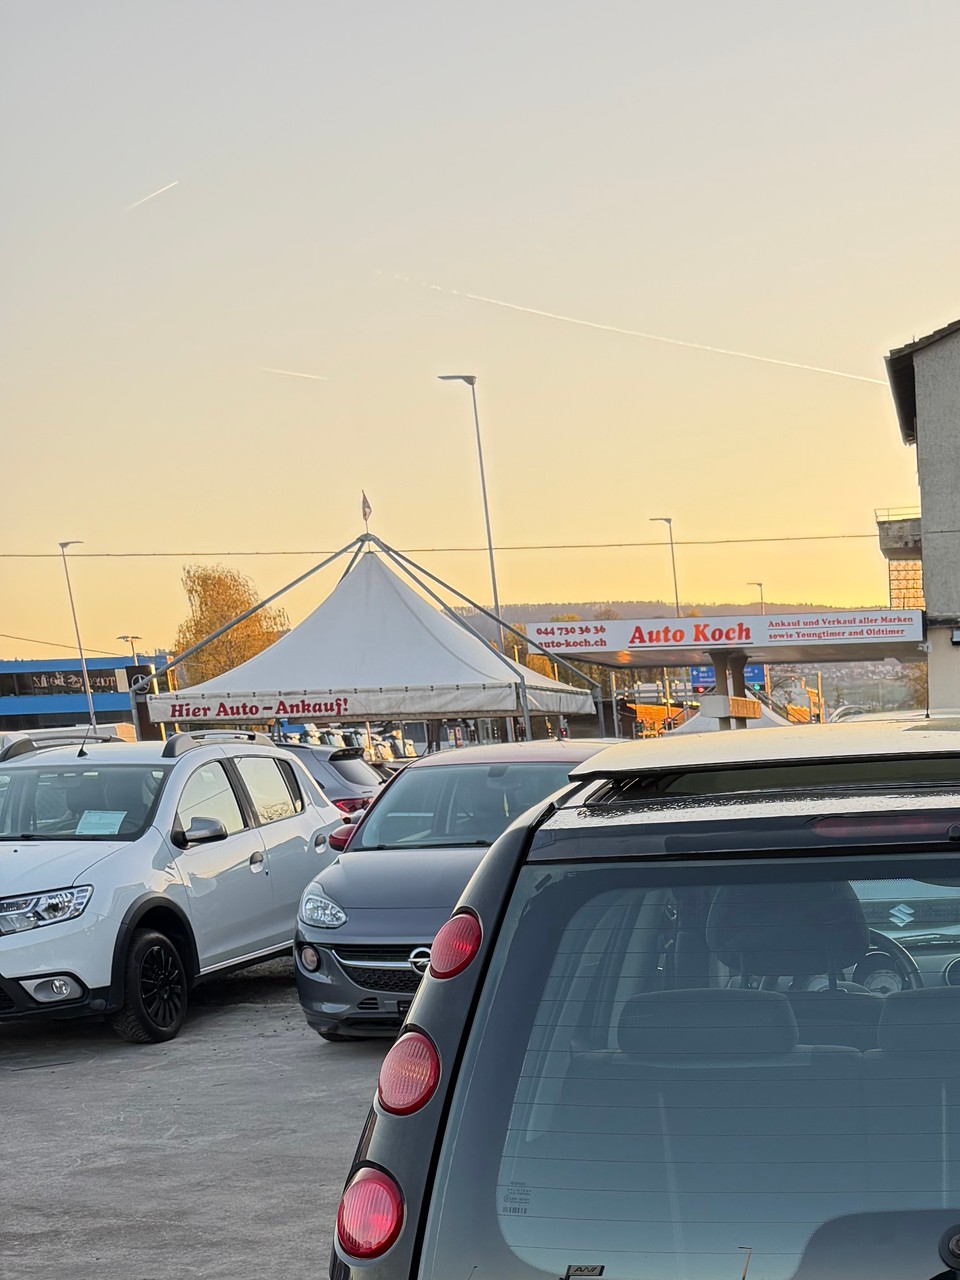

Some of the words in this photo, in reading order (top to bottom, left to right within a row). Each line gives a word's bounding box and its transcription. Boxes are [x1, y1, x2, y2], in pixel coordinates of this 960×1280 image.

[768, 619, 800, 628] Ankauf
[803, 619, 819, 627] und
[822, 617, 856, 626] Verkauf
[858, 616, 878, 625] aller
[880, 615, 913, 624] Marken
[536, 627, 555, 636] 044
[557, 626, 576, 636] 730
[578, 625, 591, 635] 36
[593, 625, 606, 634] 36
[629, 625, 685, 644] Auto
[693, 622, 751, 642] Koch
[769, 632, 793, 640] sowie
[796, 629, 846, 640] Youngtimer
[866, 628, 905, 636] Oldtimer
[170, 703, 211, 718] Hier
